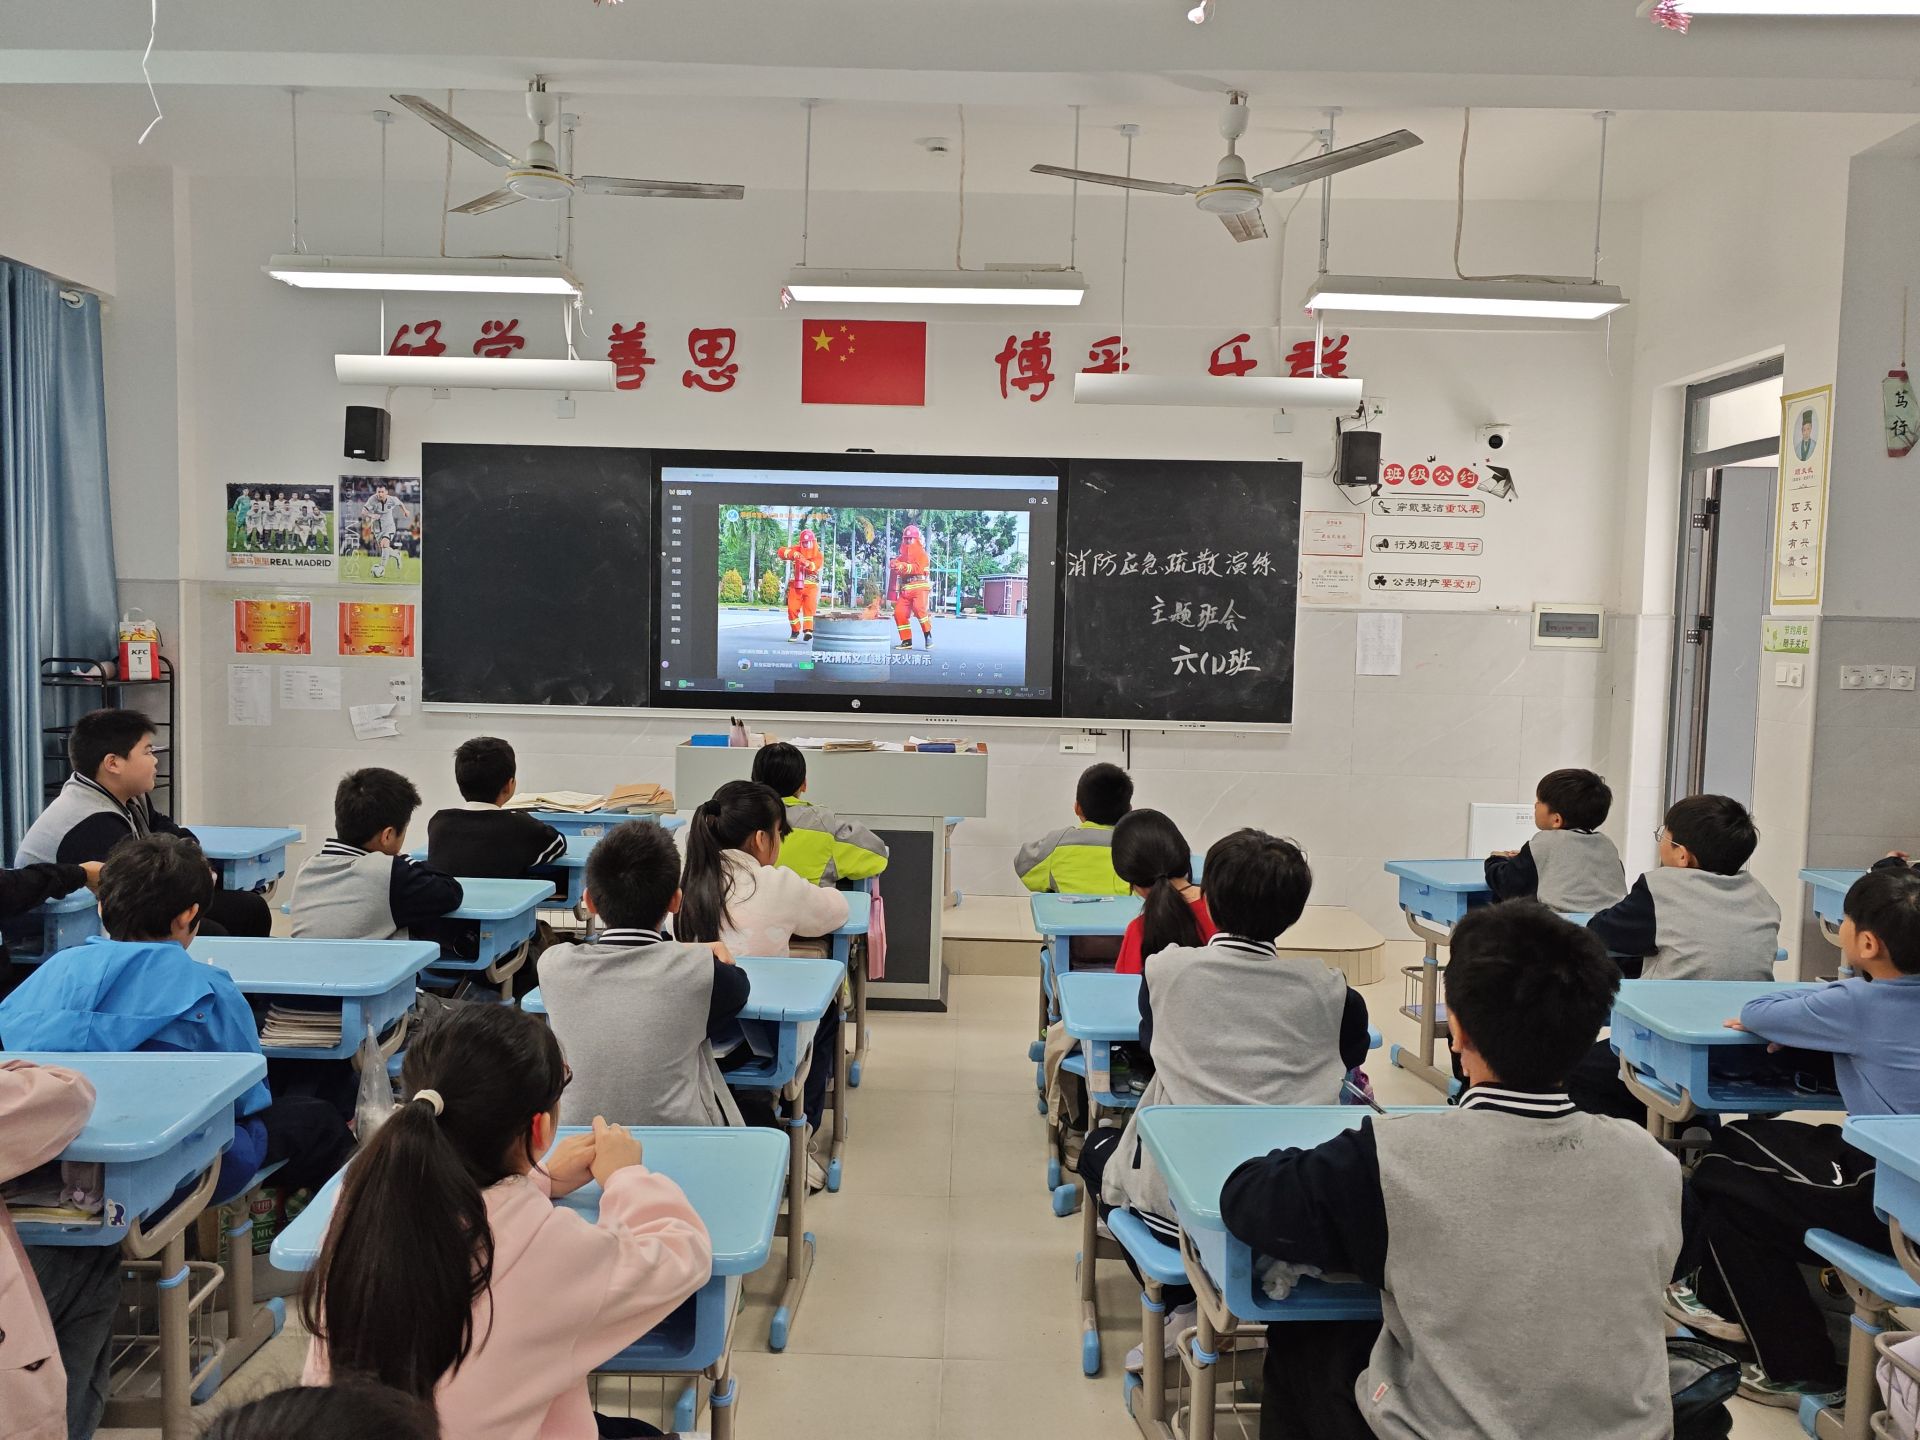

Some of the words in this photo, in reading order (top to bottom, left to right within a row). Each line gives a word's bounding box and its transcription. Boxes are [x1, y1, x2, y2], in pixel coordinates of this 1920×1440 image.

[1890, 390, 1909, 437] 笃行
[1383, 465, 1478, 486] 班级公约
[1396, 502, 1480, 515] 穿戴整洁重仪表
[344, 520, 361, 578] MESSI
[1394, 539, 1480, 552] 行为规范要遵守
[269, 558, 293, 567] REAL
[294, 558, 332, 568] MADRID
[1068, 548, 1277, 578] 消防应急疏散演练
[1392, 577, 1477, 589] 公共财产要爱护
[1151, 595, 1247, 632] 主题班会
